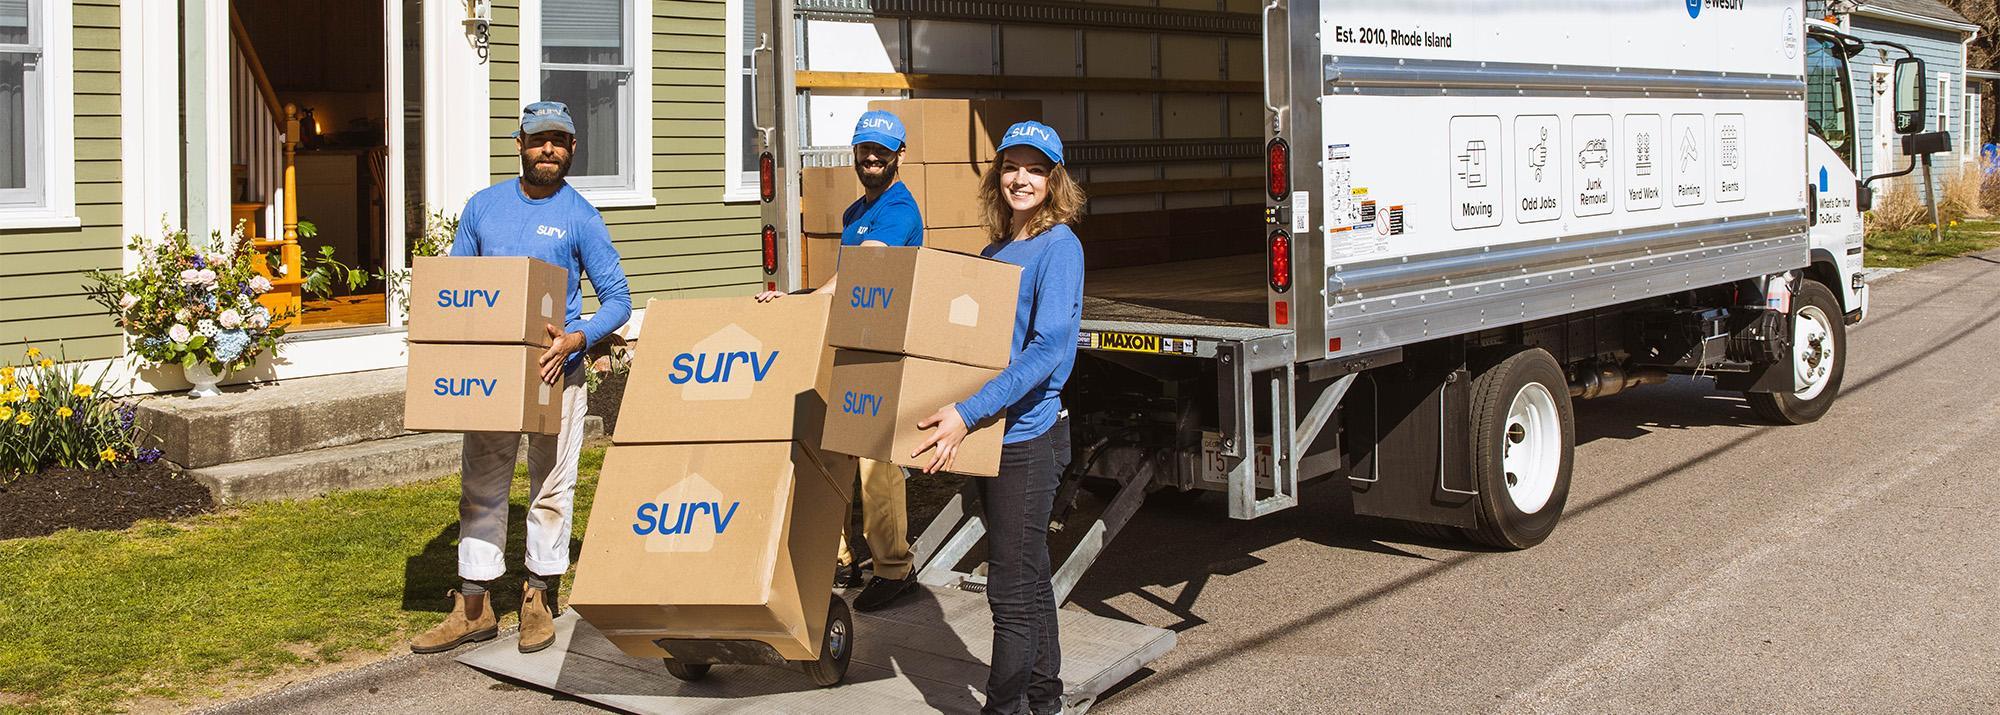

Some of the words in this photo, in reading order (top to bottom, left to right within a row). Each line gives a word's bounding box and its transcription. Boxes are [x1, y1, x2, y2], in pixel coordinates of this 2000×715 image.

[1335, 25, 1357, 43] Est.
[1359, 27, 1388, 48] 2010,
[1390, 29, 1422, 46] Rhode
[1424, 31, 1452, 48] Island
[862, 118, 894, 131] surv
[1011, 126, 1050, 141] surv
[1586, 178, 1602, 191] Junk
[1678, 184, 1700, 197] Painting
[1722, 181, 1739, 192] Events
[1580, 191, 1608, 206] Removal
[1629, 188, 1642, 201] Yard
[1643, 187, 1660, 200] Work
[1462, 201, 1493, 218] Moving
[1522, 196, 1538, 211] Odd
[1539, 195, 1557, 209] Jobs
[1819, 213, 1832, 224] To-Do
[536, 224, 567, 240] surv
[437, 289, 500, 308] surv
[850, 285, 894, 309] surv
[1103, 333, 1155, 350] MAXON
[668, 351, 780, 385] surv
[433, 377, 497, 397] surv
[842, 390, 883, 416] surv
[632, 501, 740, 536] surv
